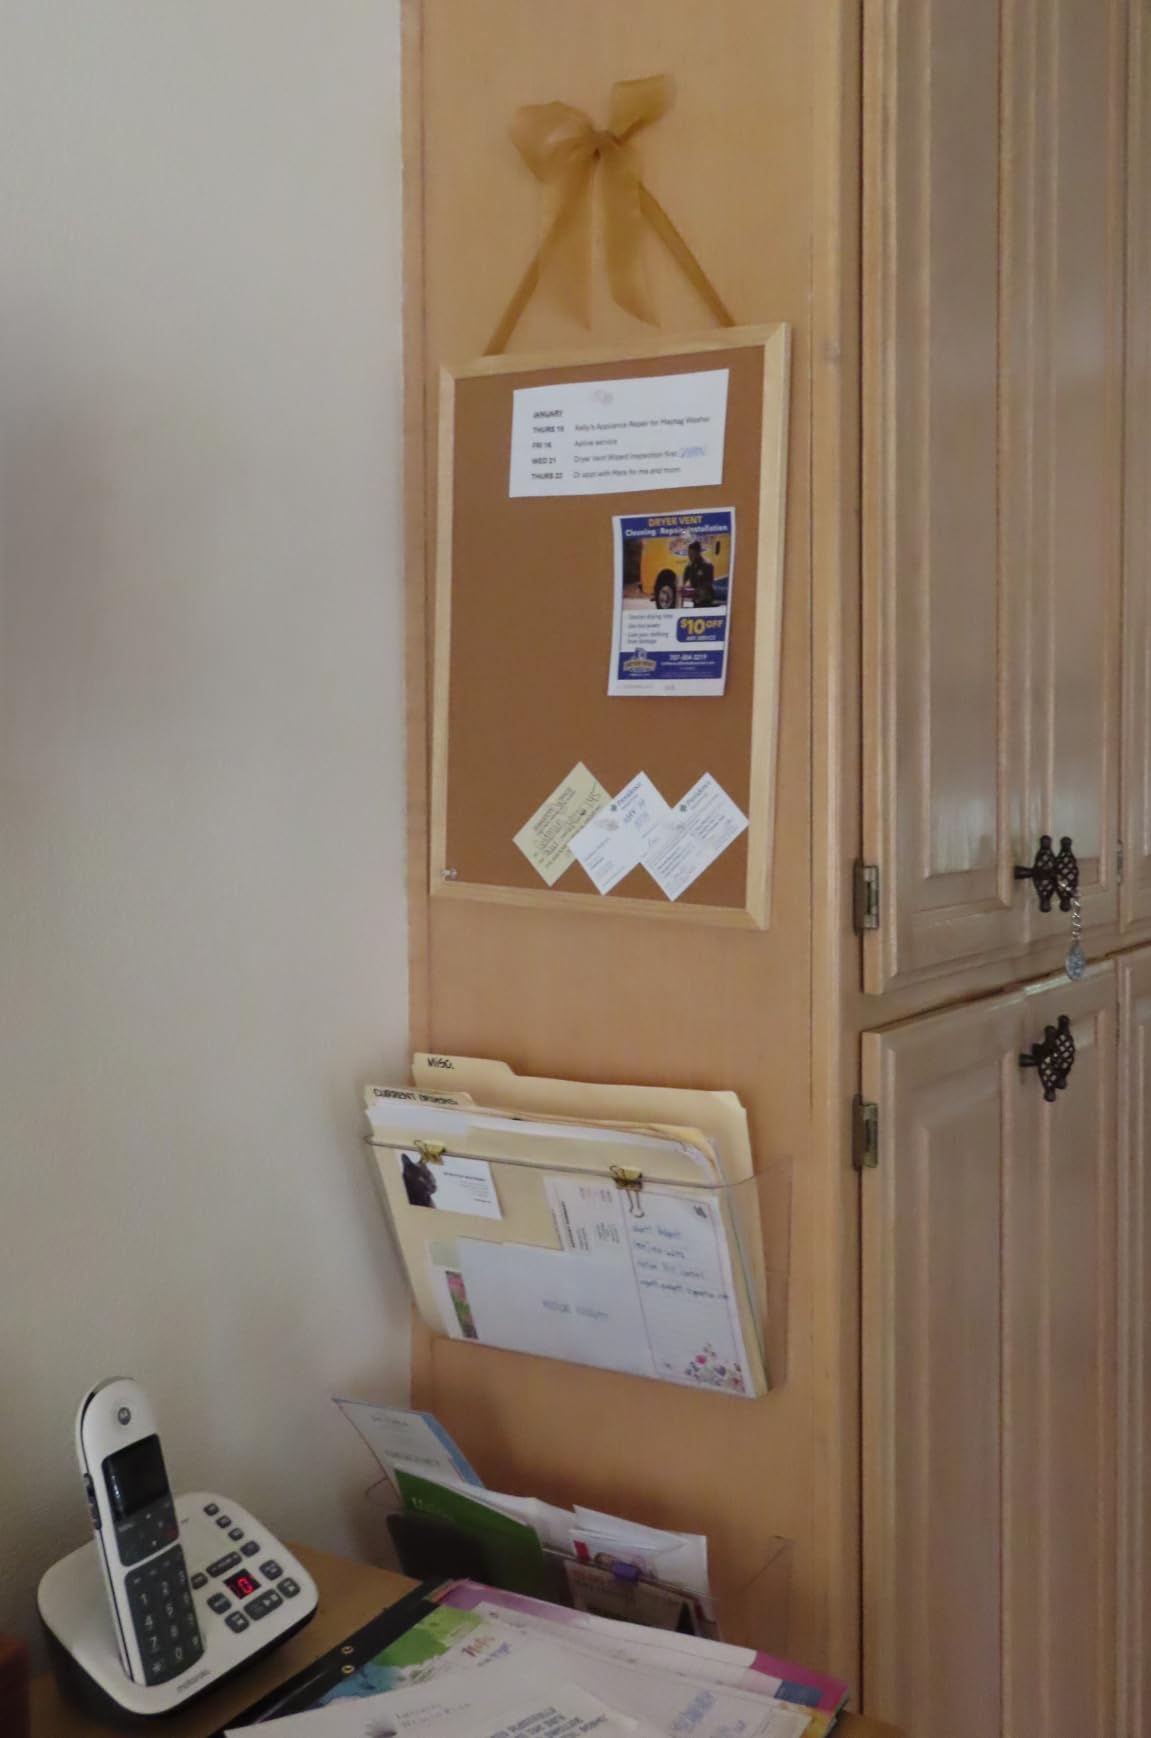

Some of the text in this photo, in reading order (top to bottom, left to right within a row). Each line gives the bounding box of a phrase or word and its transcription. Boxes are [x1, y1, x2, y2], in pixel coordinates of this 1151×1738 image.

[532, 409, 563, 418] JANUARY
[648, 515, 703, 527] DRYER VENT
[680, 618, 724, 634] $10 OFF
